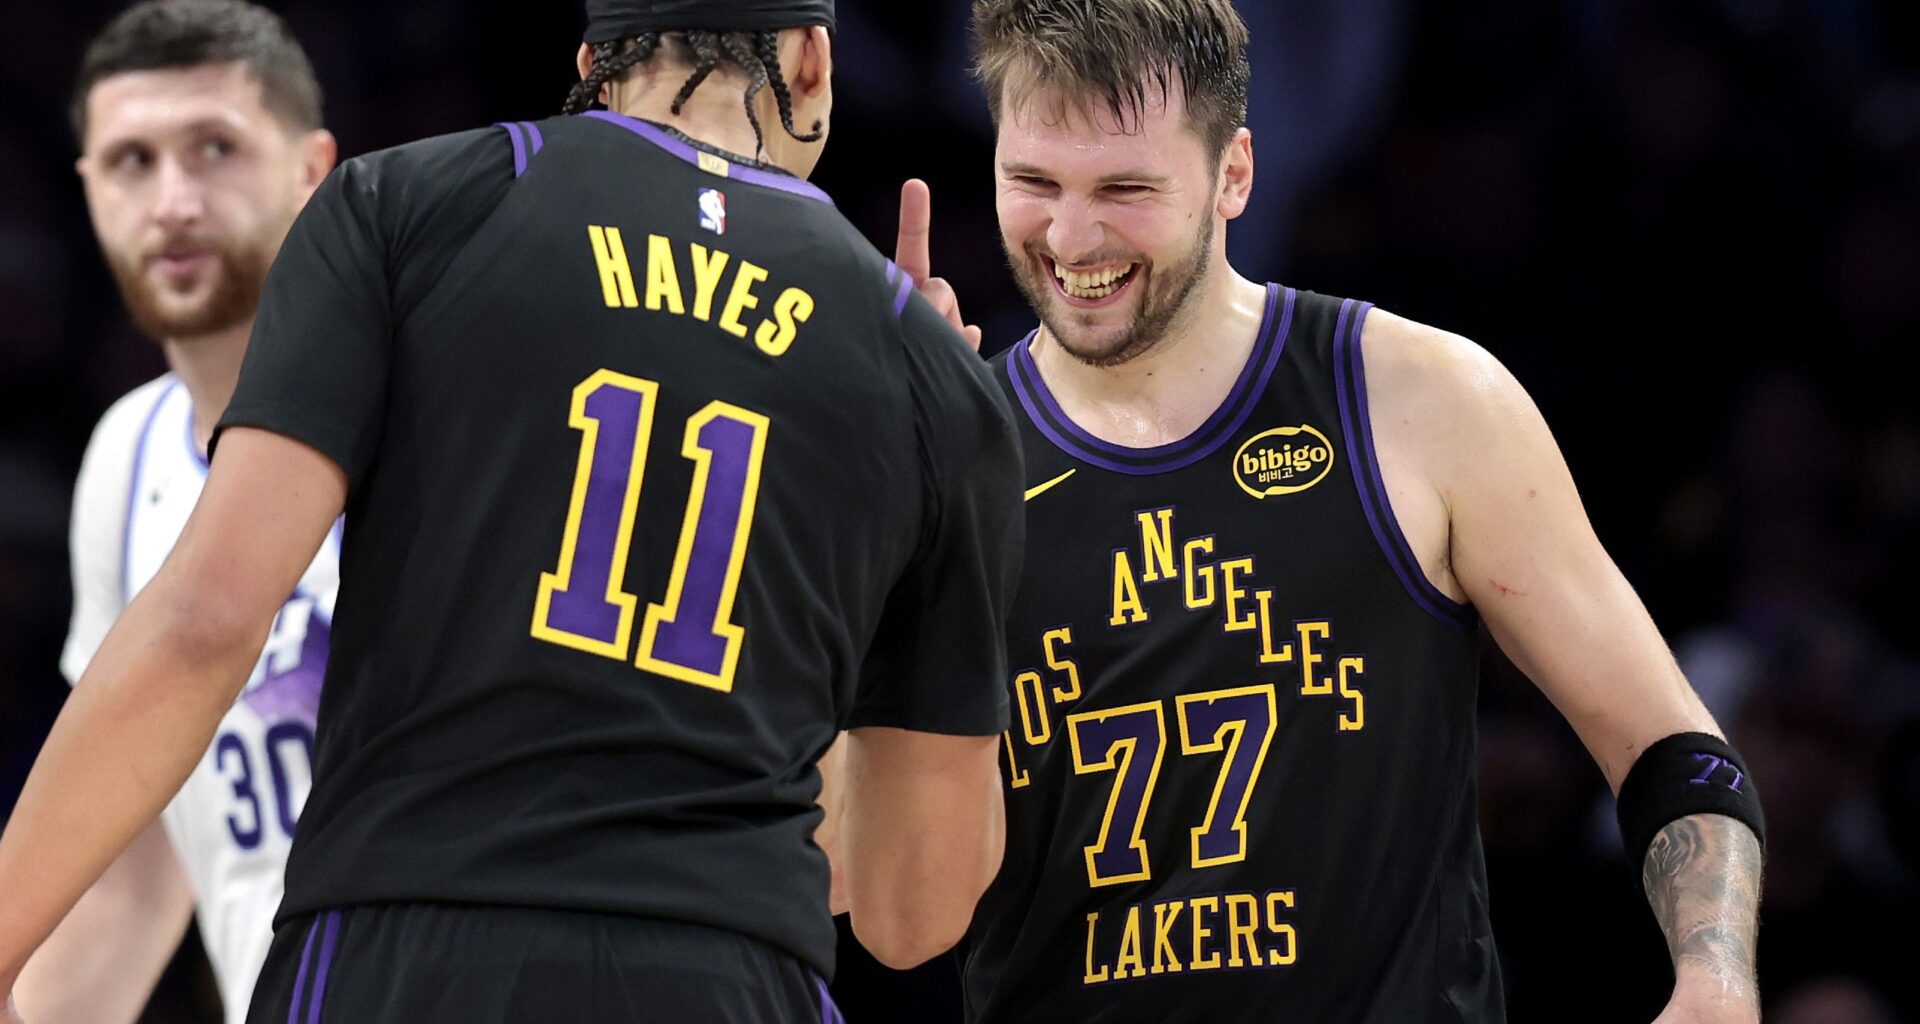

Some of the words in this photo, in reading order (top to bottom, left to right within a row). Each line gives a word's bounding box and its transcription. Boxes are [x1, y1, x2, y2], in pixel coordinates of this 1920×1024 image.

[588, 225, 814, 357] HAYES
[1242, 444, 1327, 475] bibigo
[1259, 467, 1294, 482] 비비고
[530, 368, 771, 693] 11
[1109, 508, 1364, 731] ANGELES
[217, 721, 314, 850] 30
[1066, 683, 1277, 887] 77
[1688, 751, 1744, 794] 77
[1084, 891, 1297, 984] LAKERS
